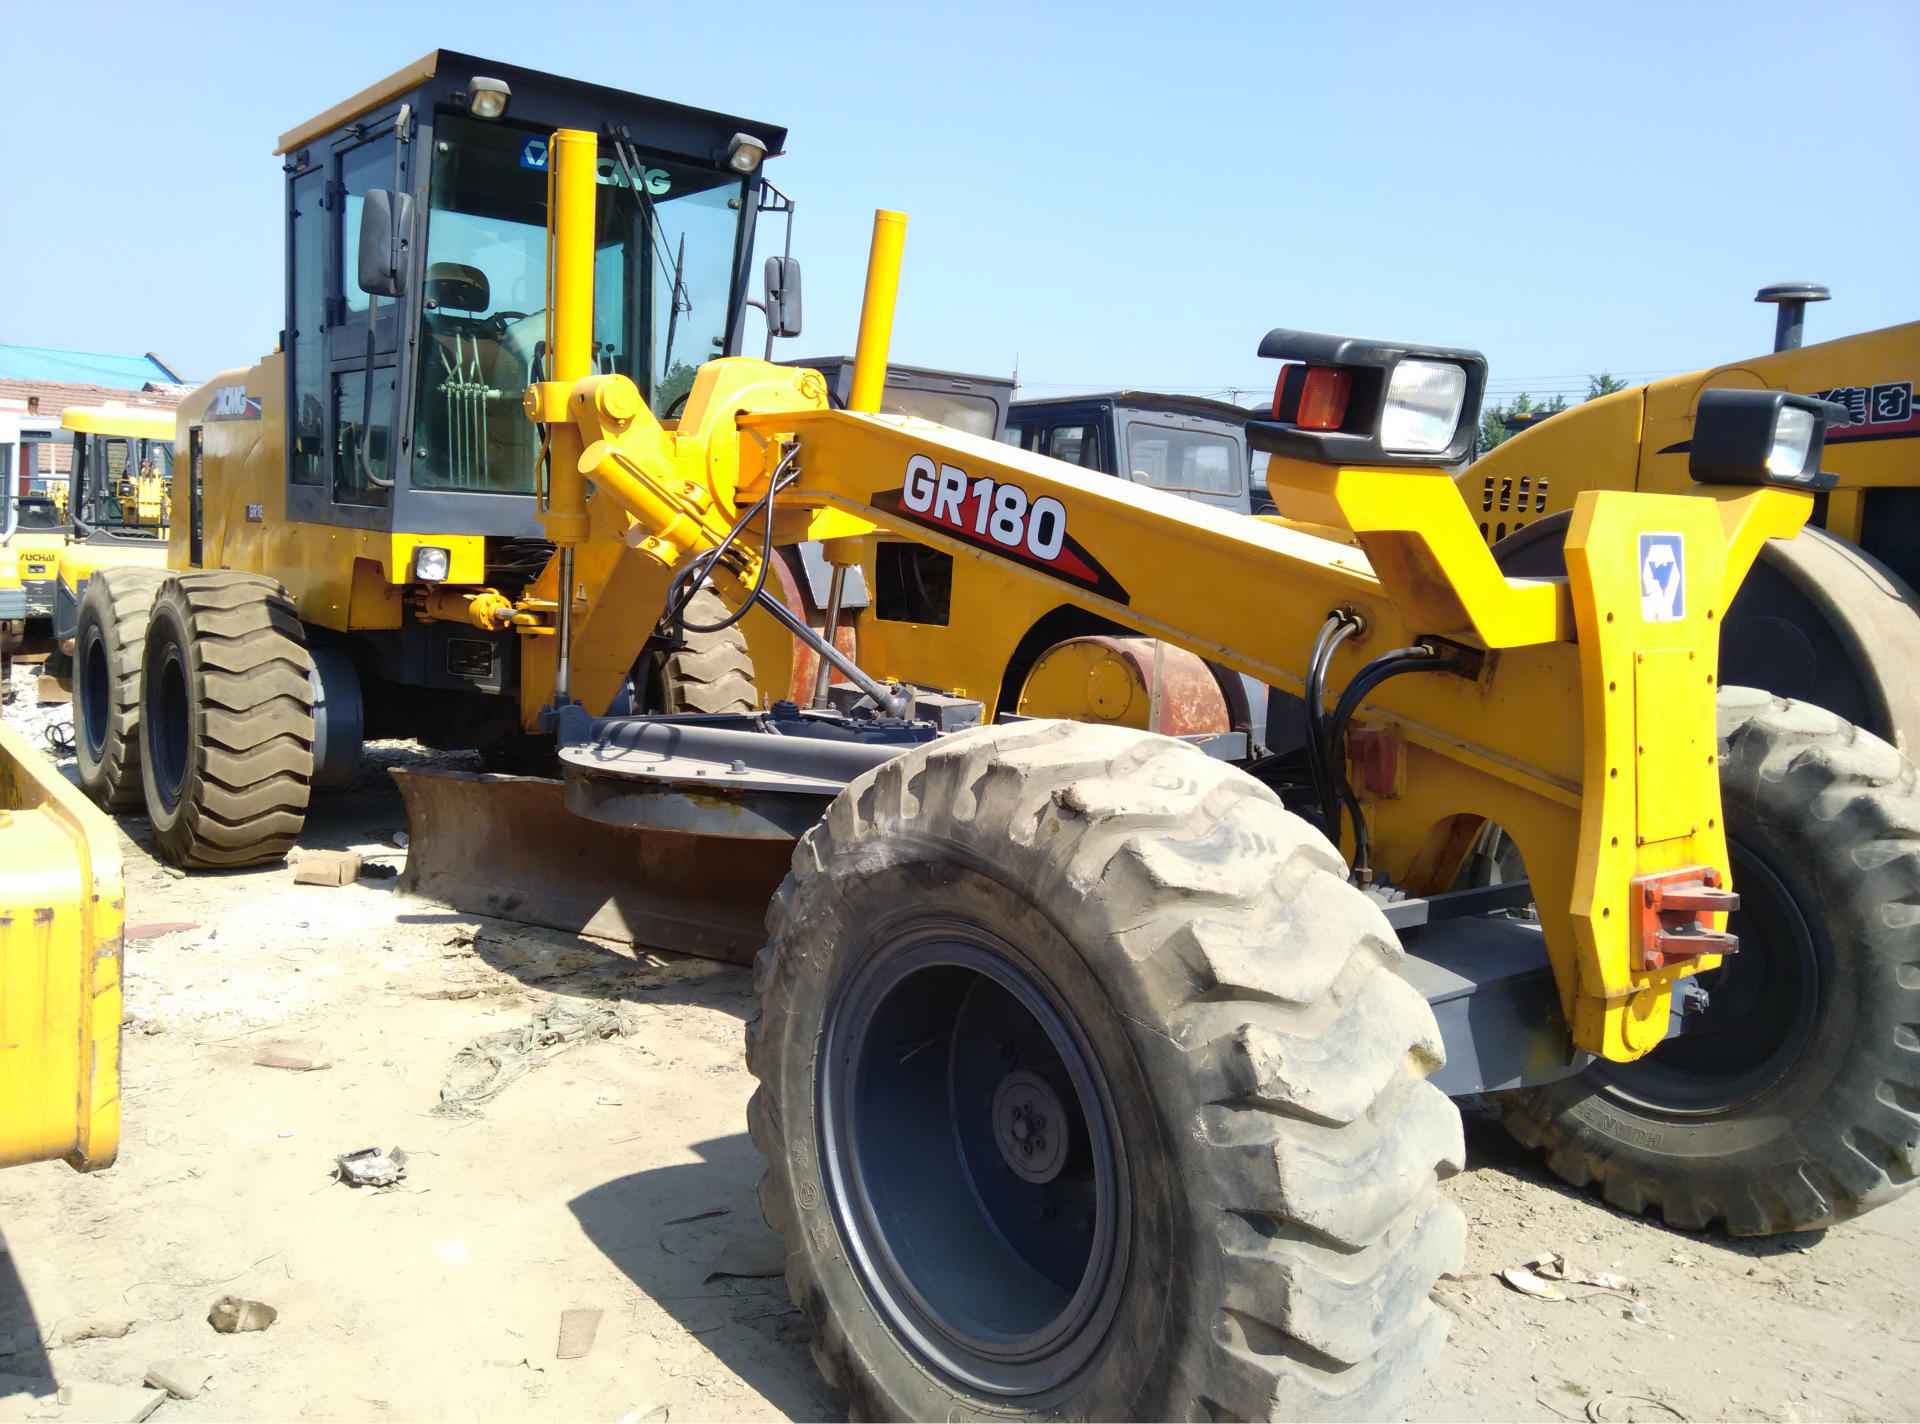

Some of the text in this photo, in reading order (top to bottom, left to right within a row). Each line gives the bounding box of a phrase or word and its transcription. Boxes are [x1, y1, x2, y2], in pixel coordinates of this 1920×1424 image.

[595, 157, 672, 196] CMG
[1810, 381, 1913, 428] 集团
[903, 453, 1067, 561] GR180
